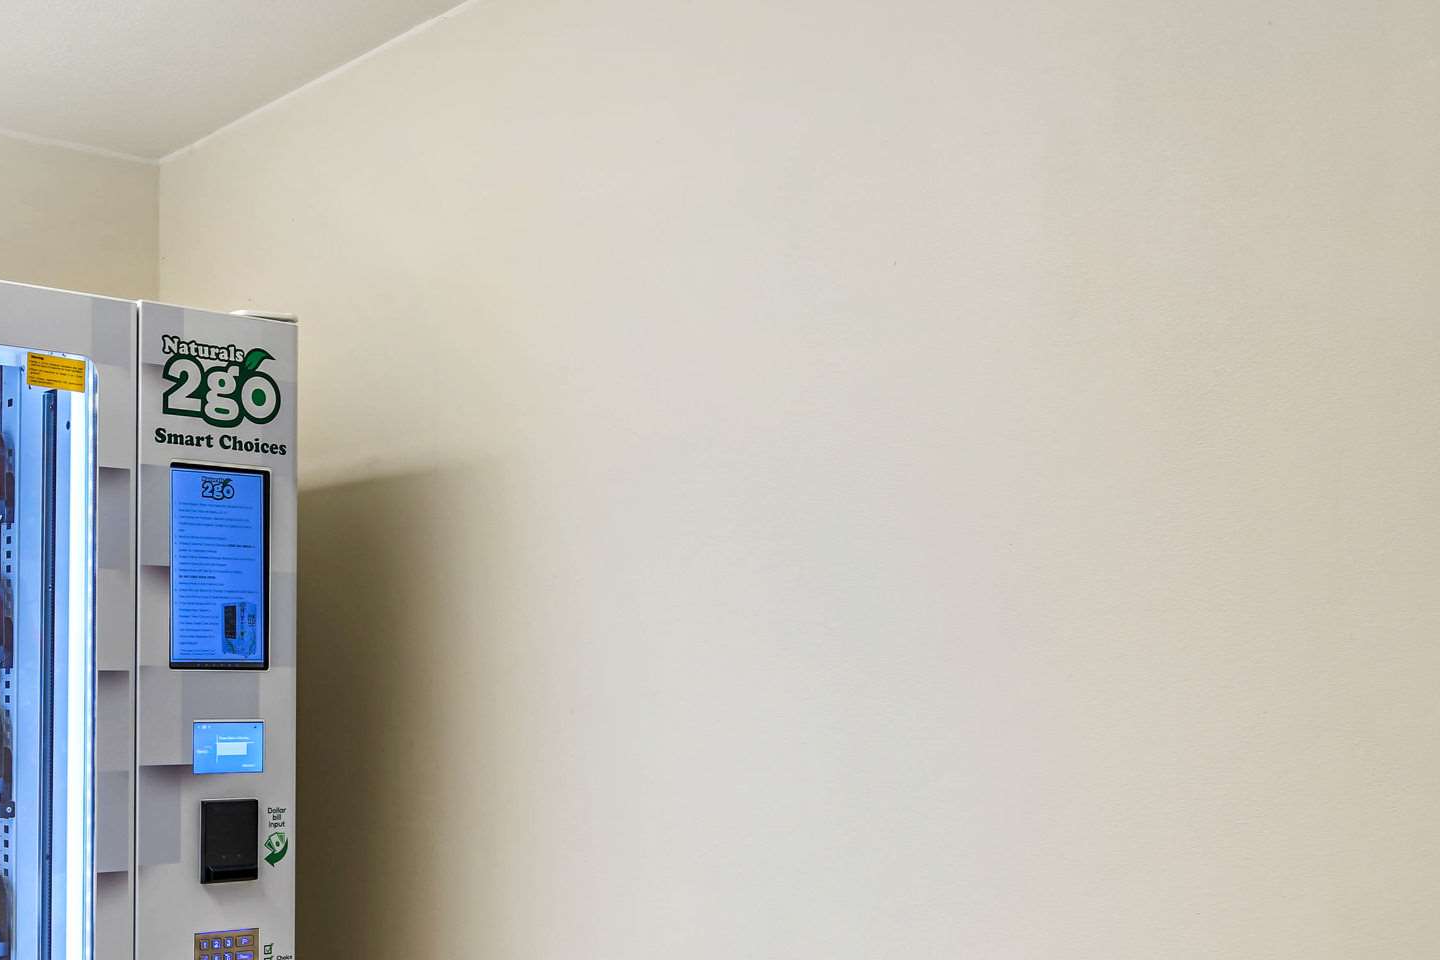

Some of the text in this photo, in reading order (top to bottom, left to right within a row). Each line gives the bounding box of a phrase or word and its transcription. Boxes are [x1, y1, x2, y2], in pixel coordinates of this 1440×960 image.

[162, 335, 245, 362] Naturals
[162, 354, 281, 428] 2go
[154, 428, 287, 455] Smart Choices
